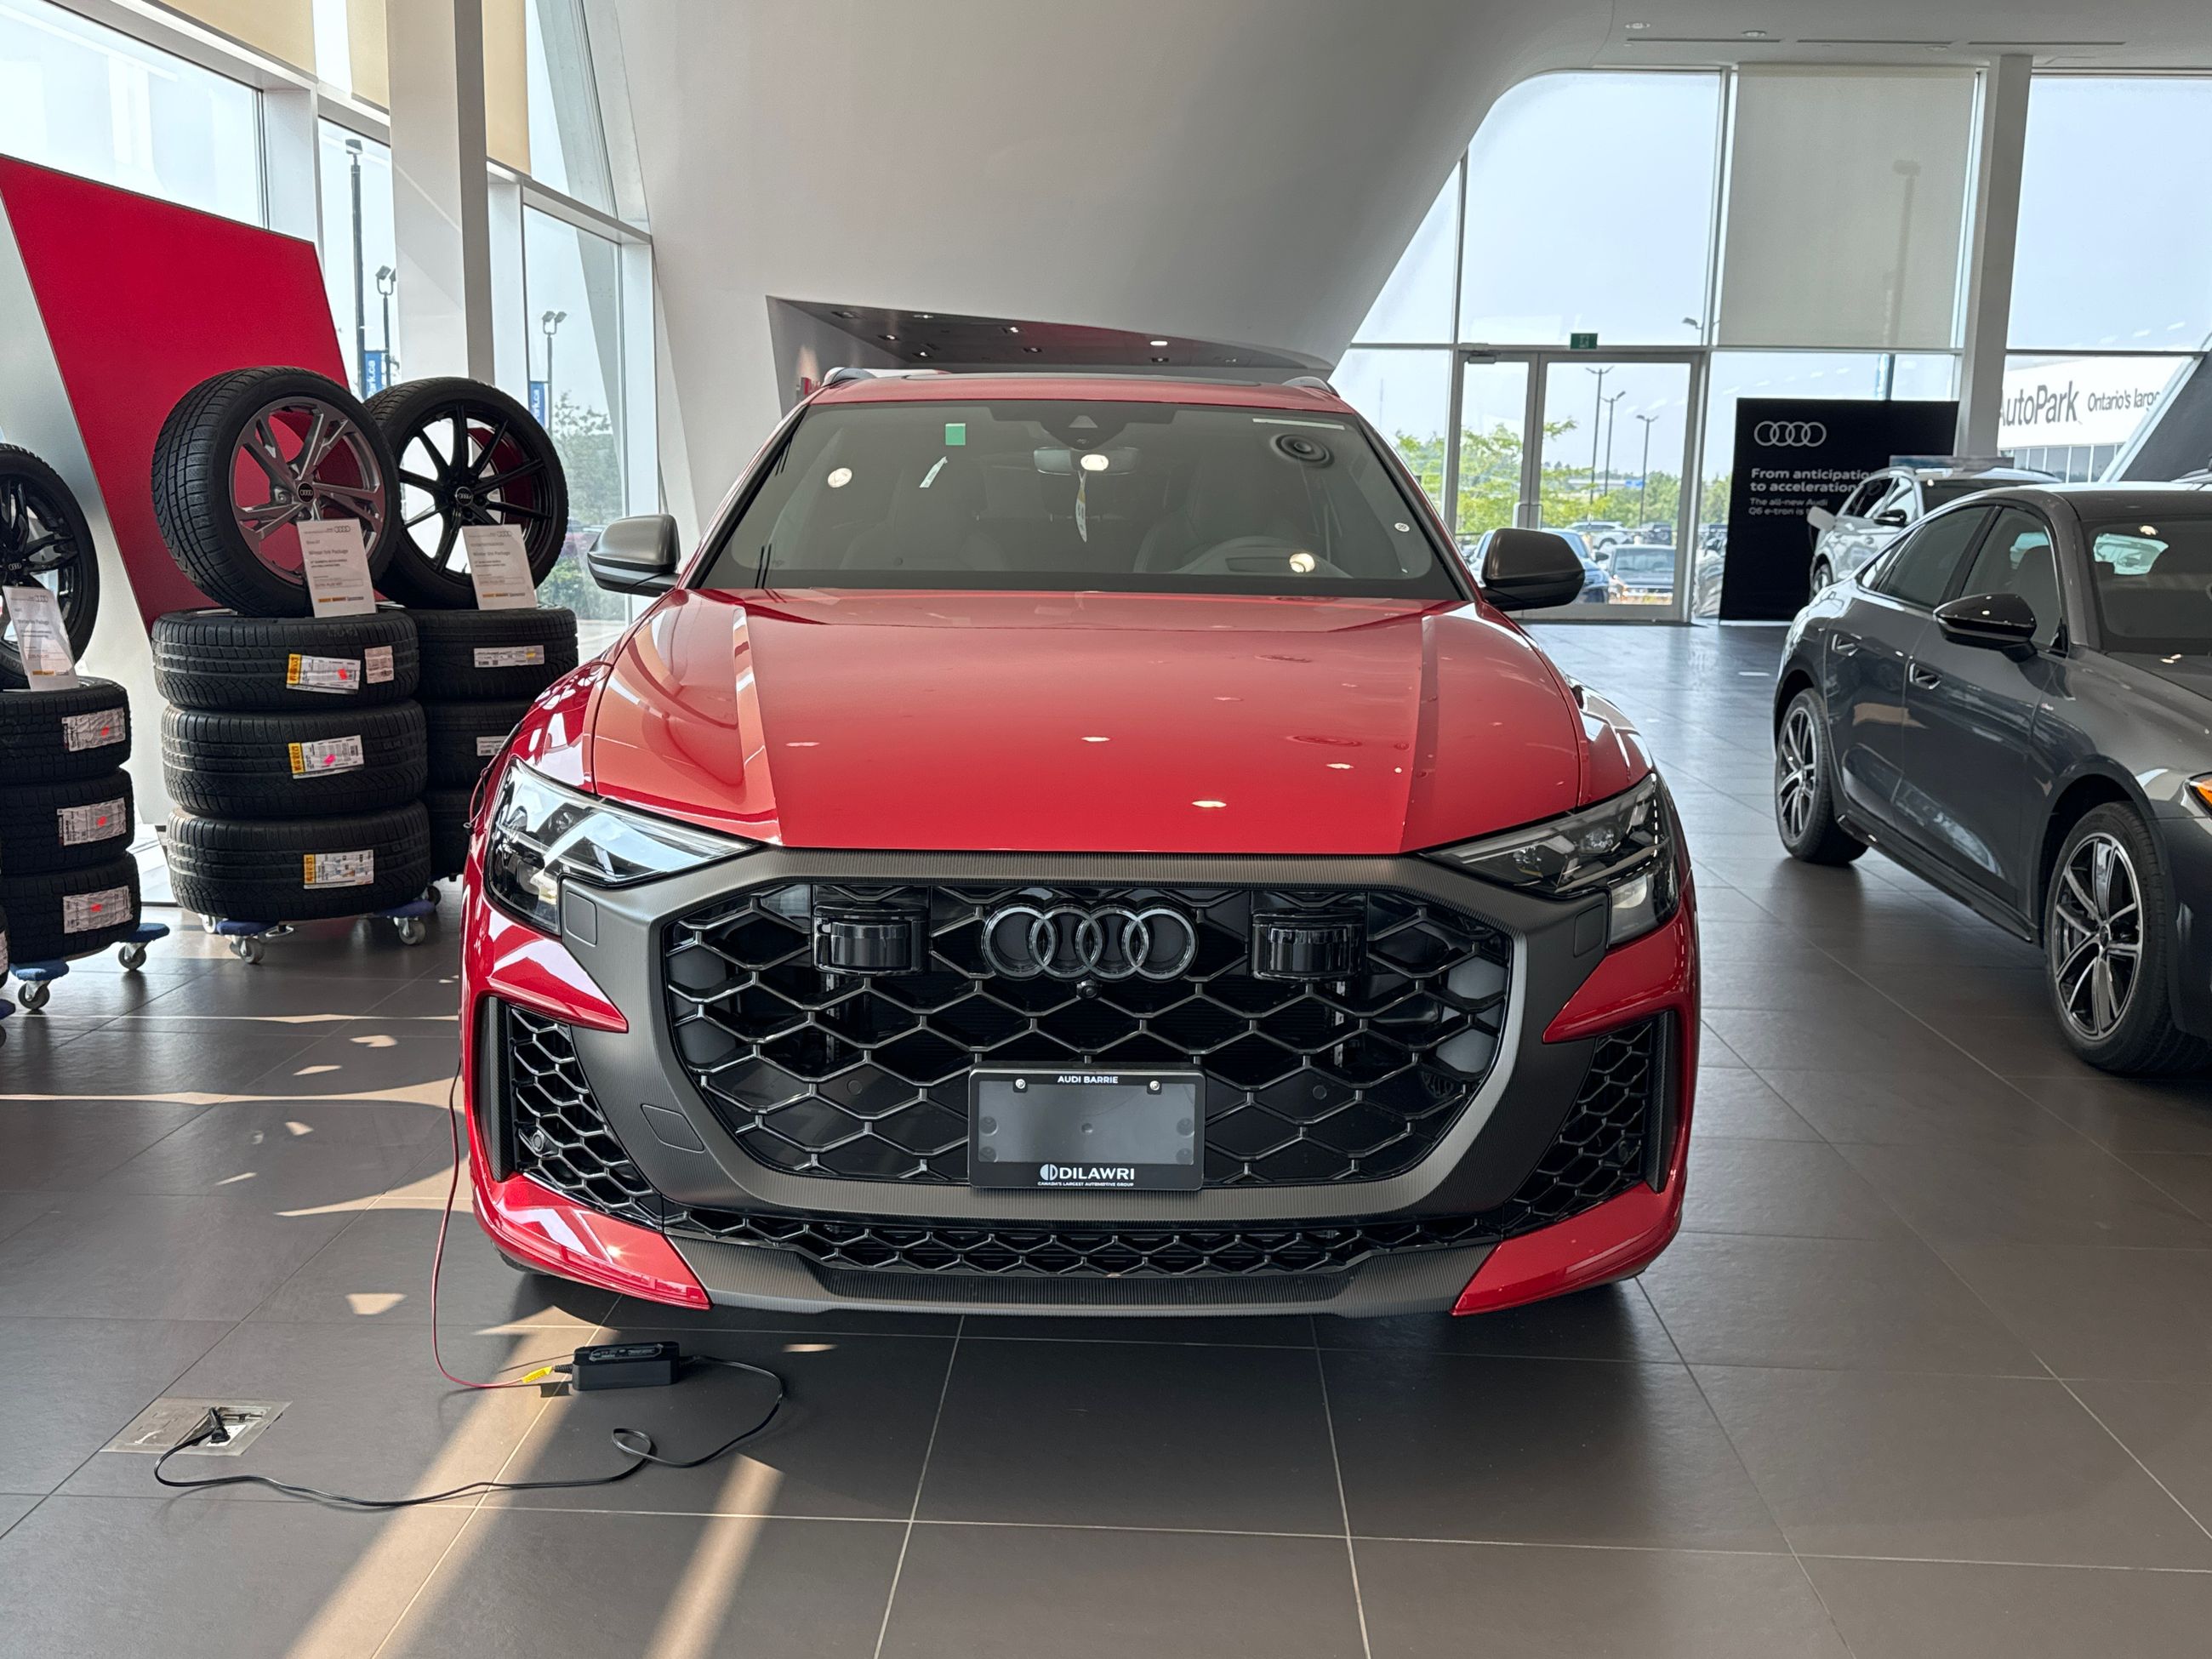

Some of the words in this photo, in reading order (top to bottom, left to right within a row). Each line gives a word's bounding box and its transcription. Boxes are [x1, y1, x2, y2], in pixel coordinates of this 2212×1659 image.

[2088, 390, 2131, 413] Ontario's
[1751, 468, 1790, 479] From
[1793, 469, 1873, 482] anticipatio
[1750, 482, 1767, 492] to
[1750, 498, 1768, 506] The
[1083, 1075, 1119, 1084] BARRIE
[1059, 1167, 1135, 1180] DILAWRI
